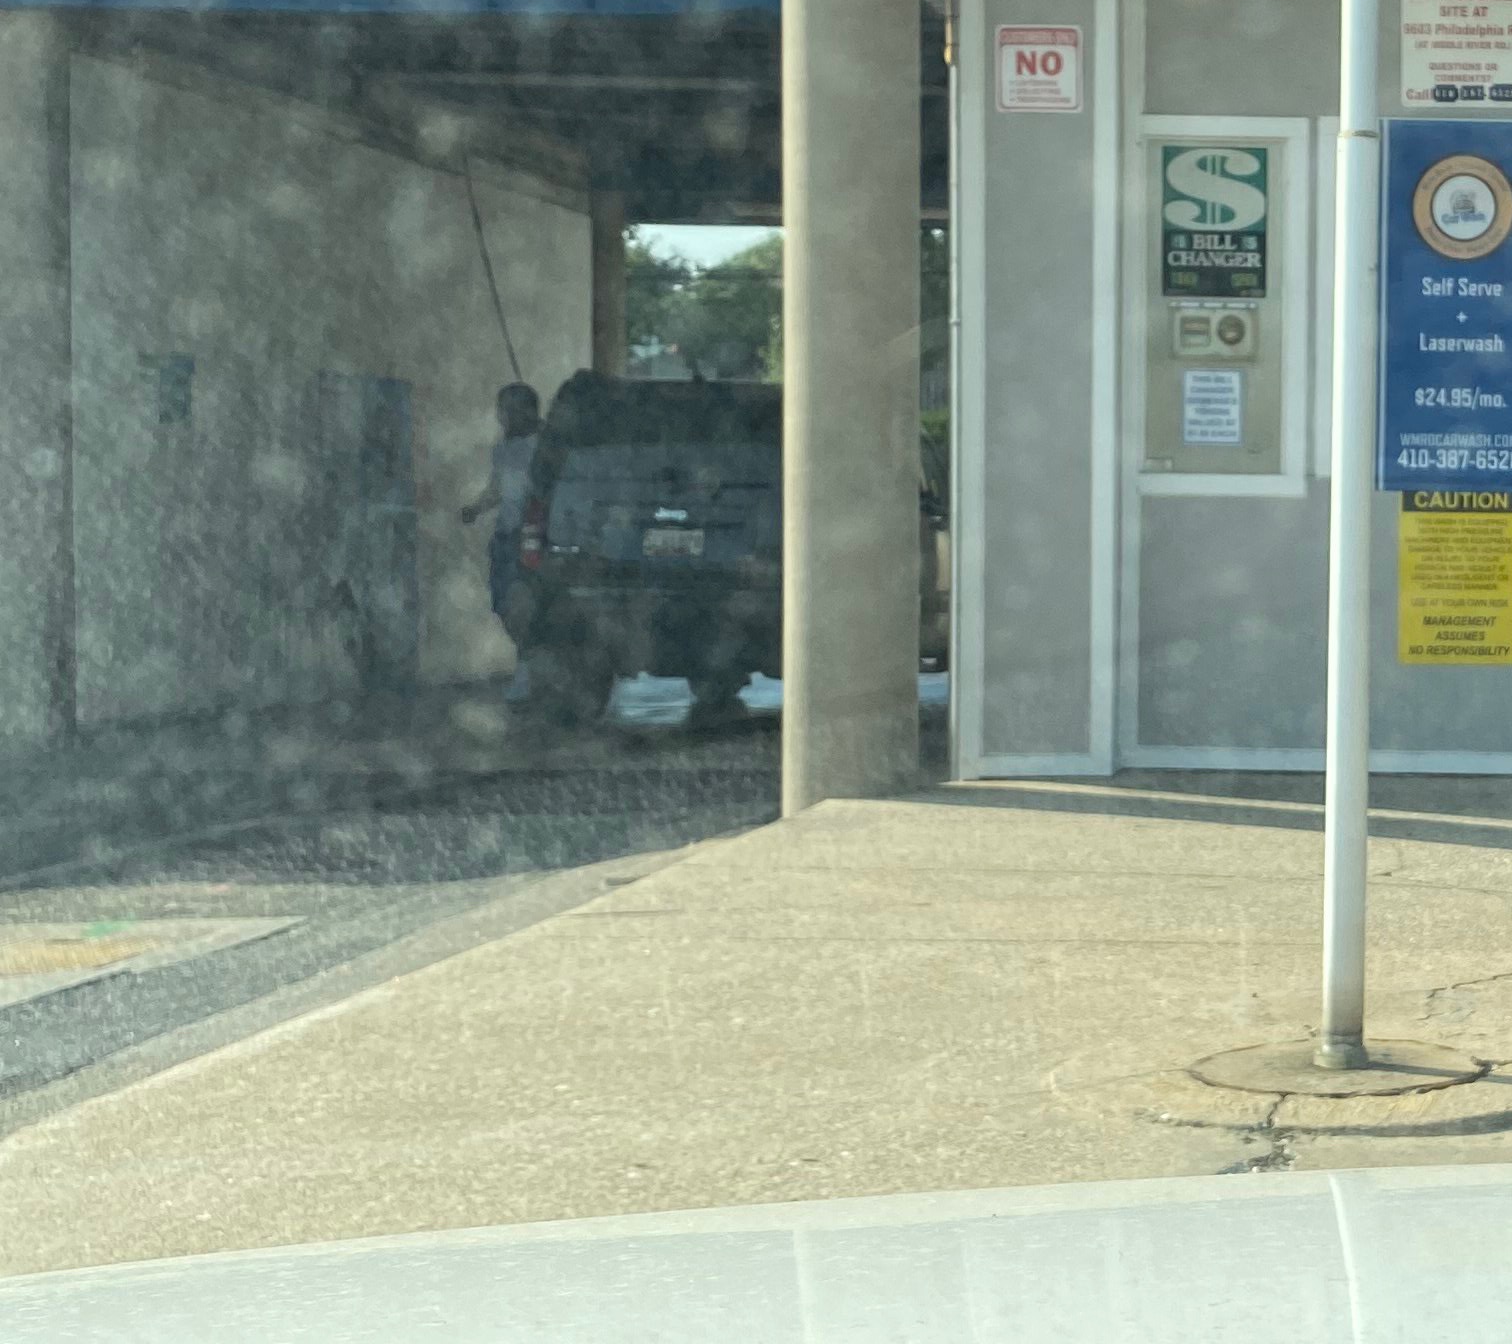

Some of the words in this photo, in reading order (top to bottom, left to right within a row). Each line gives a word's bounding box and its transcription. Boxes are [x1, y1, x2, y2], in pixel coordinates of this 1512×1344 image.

[1440, 6, 1468, 17] SITE
[1472, 6, 1488, 17] AT
[1435, 24, 1504, 37] Philadelphia
[1015, 50, 1064, 76] NO
[1192, 234, 1238, 250] BILL
[1167, 250, 1262, 267] CHANGER
[1421, 276, 1454, 296] Self
[1458, 277, 1503, 297] Serve
[1420, 332, 1504, 353] Laserwash
[1414, 386, 1508, 411] $24.95/mo.
[1413, 490, 1508, 509] CAUTION
[1422, 615, 1497, 627] MANAGEMENT
[1435, 630, 1485, 642] ASSUMES
[1427, 645, 1511, 657] RESPONSIBILITY
